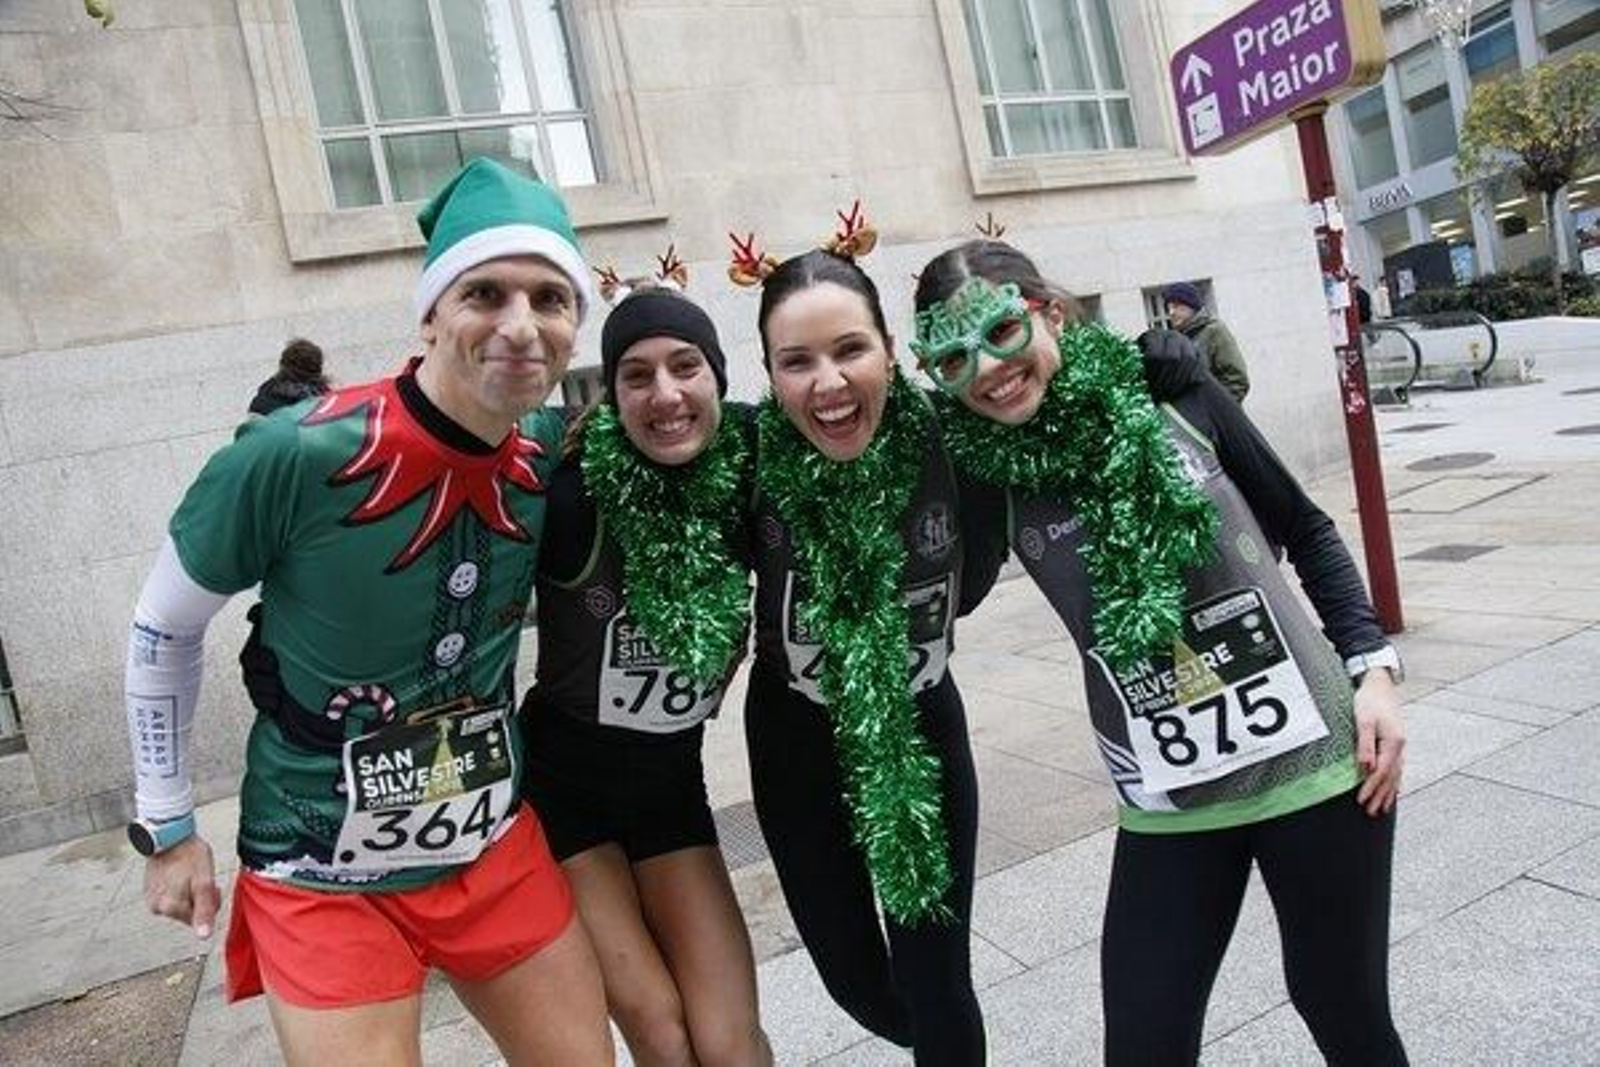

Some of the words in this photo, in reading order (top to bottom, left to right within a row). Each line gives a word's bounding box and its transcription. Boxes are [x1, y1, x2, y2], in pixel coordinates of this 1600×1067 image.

[1233, 0, 1332, 68] Praza
[1238, 41, 1339, 117] Maior
[1124, 642, 1234, 704] SILVESTRE
[1150, 674, 1289, 768] 875
[358, 748, 414, 777] SAN
[362, 751, 476, 799] SILVESTRE
[361, 788, 496, 852] 364
